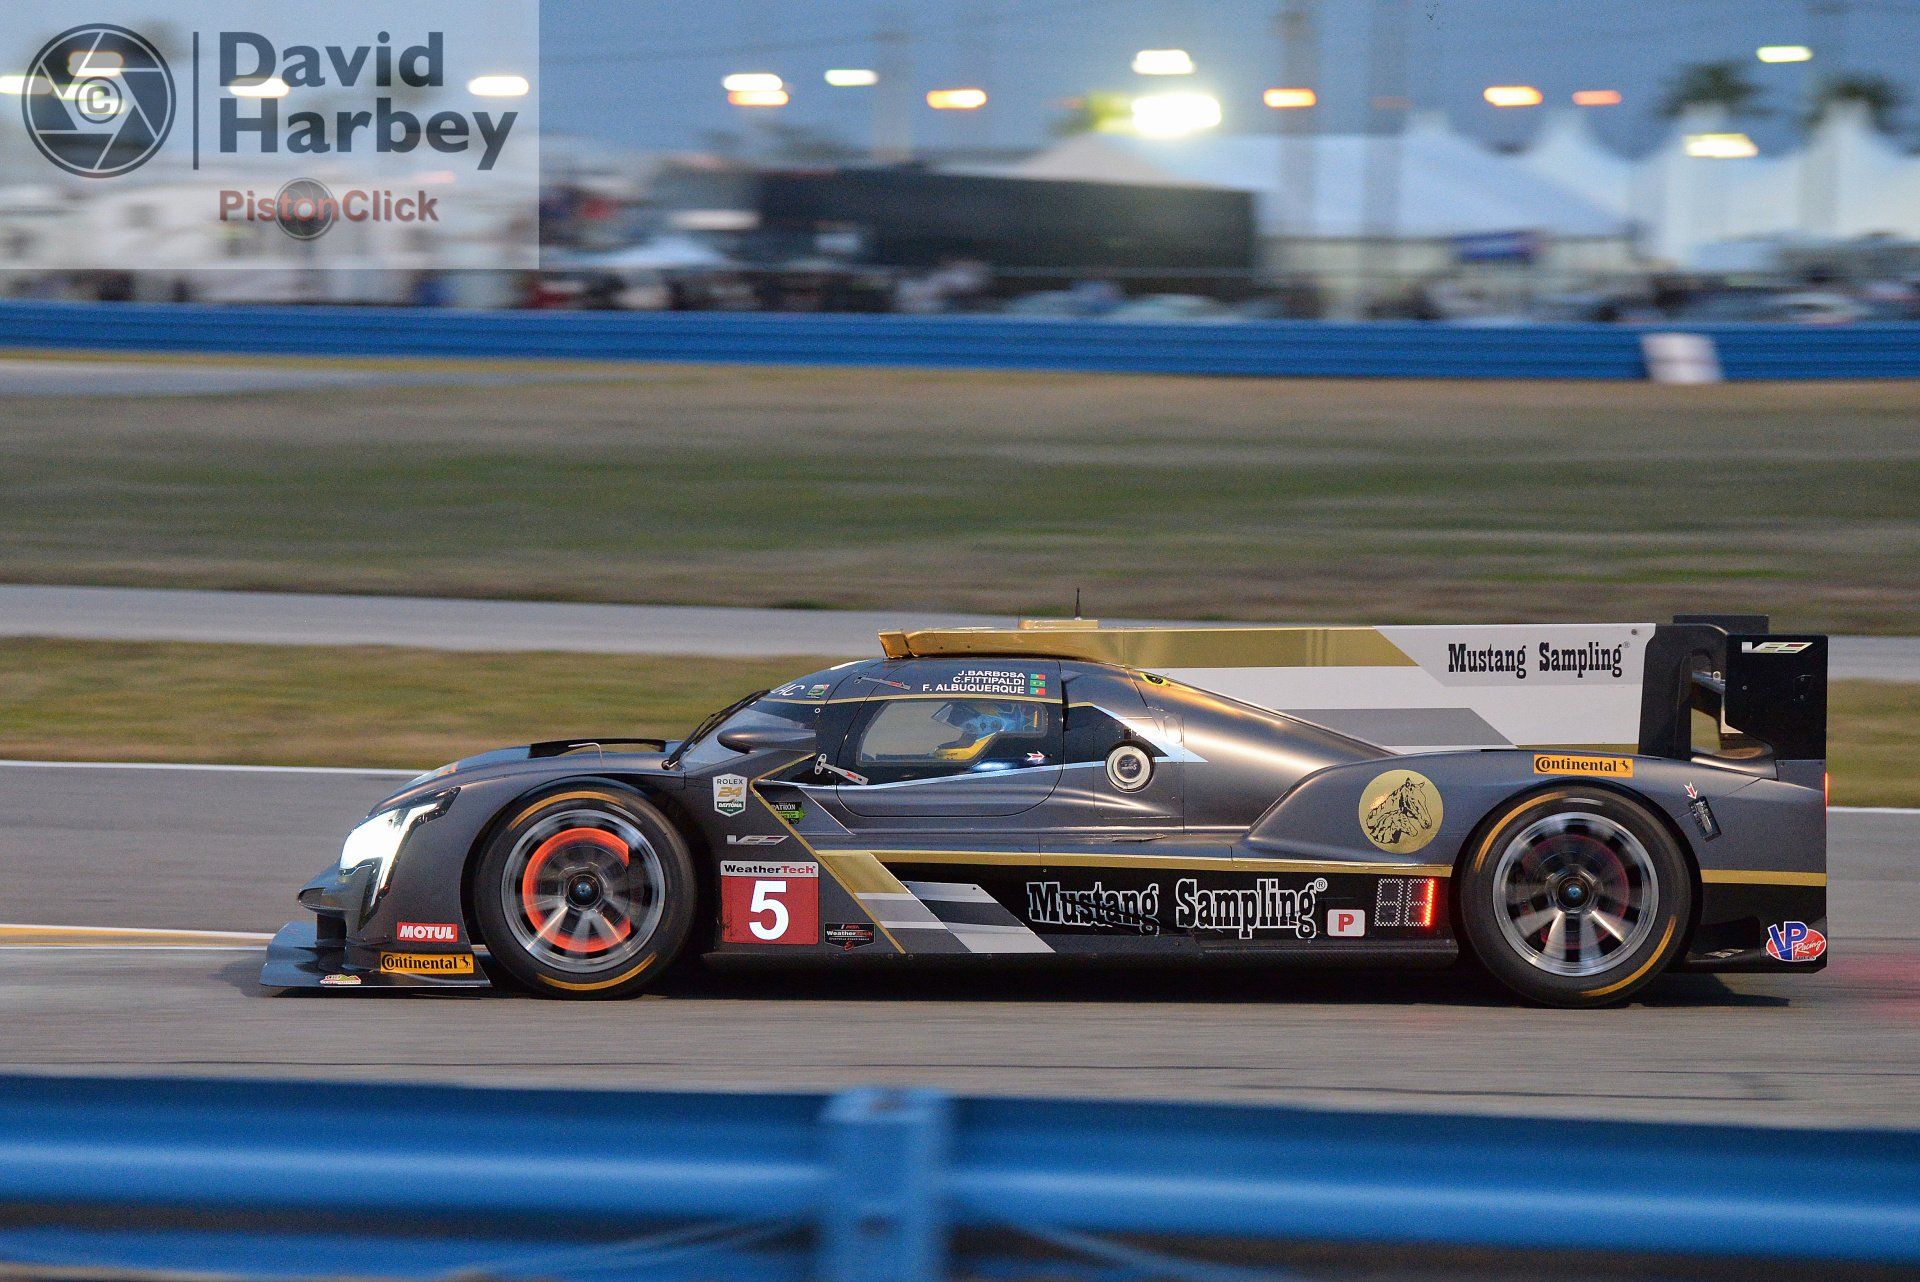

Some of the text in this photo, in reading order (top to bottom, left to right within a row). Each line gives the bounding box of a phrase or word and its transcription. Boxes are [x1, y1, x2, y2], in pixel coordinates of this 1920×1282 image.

[1448, 643, 1527, 679] Mustang
[952, 676, 1025, 686] C.FITTIPALDI
[957, 670, 1026, 678] J.BARBOSA
[922, 683, 1025, 694] F. ALBUQUERQUE
[1535, 756, 1617, 772] Continental
[717, 786, 743, 798] 24
[723, 864, 814, 874] WeatherTech
[748, 880, 790, 940] 5
[1026, 881, 1160, 936] Mustang
[1337, 913, 1355, 932] P
[399, 925, 455, 940] MOTUL
[1767, 921, 1824, 961] VP Racing
[381, 953, 458, 971] Continental
